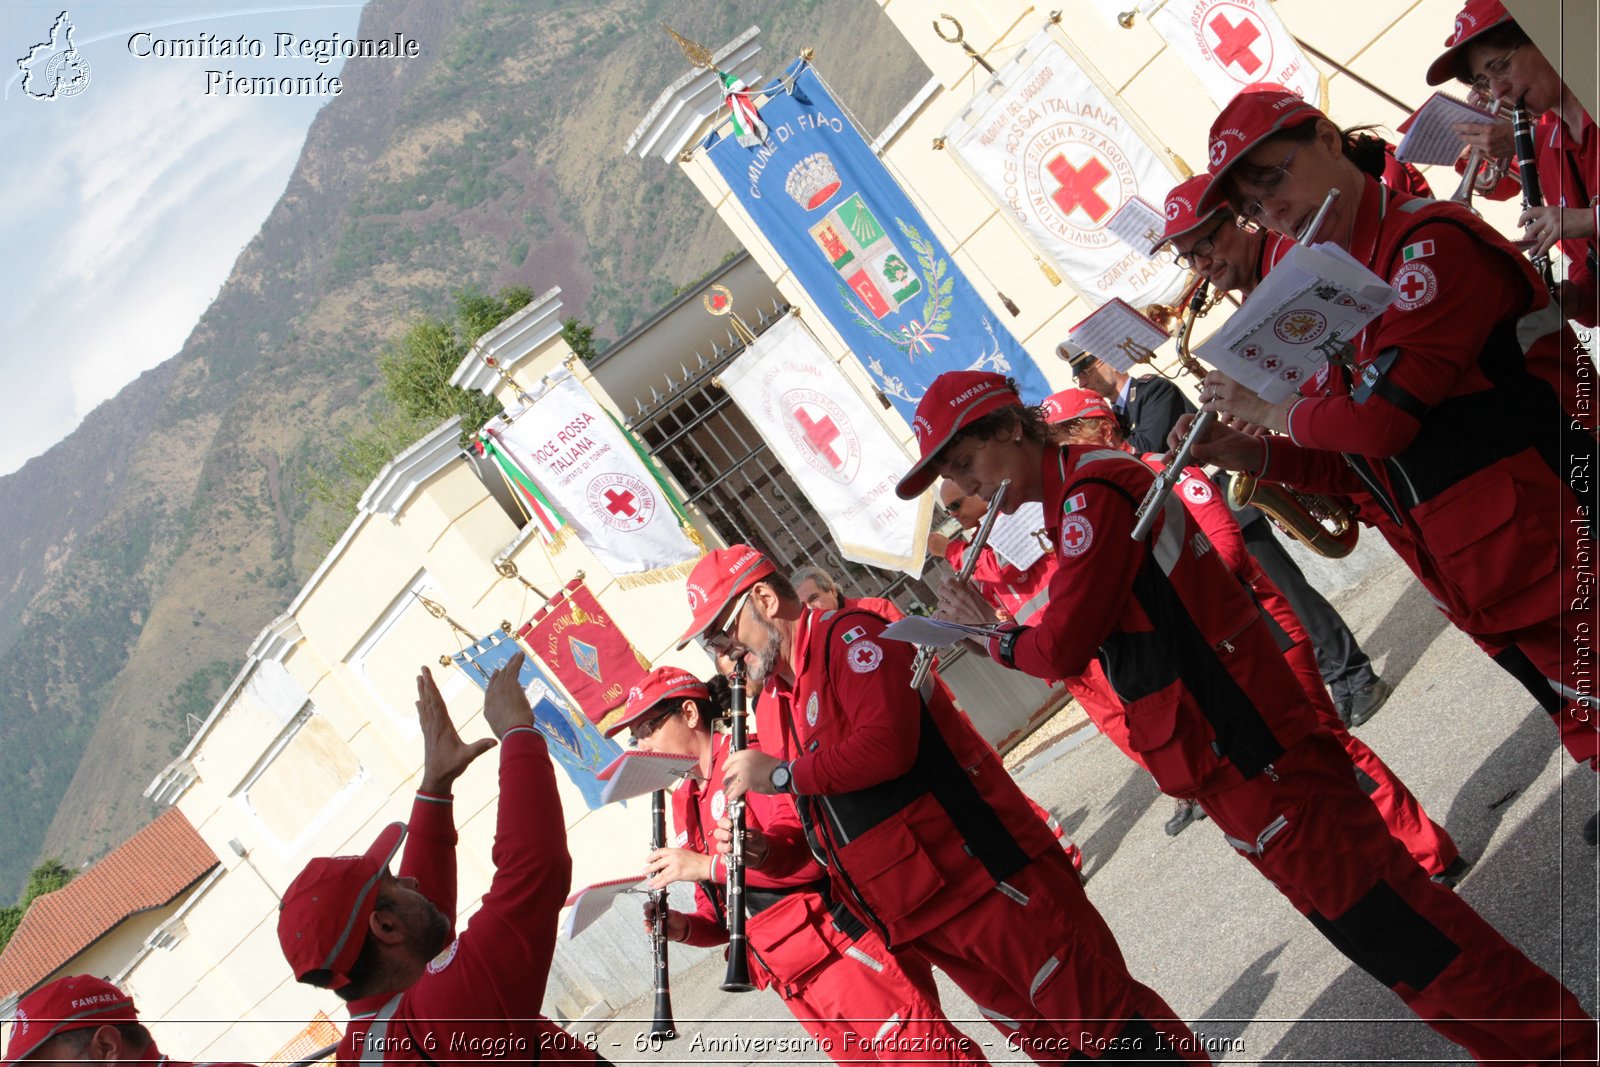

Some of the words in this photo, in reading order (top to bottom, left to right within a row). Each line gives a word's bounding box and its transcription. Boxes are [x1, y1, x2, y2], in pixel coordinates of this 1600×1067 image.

[1040, 98, 1120, 132] ITALIANA
[775, 122, 795, 143] DI
[1005, 107, 1042, 158] ROSSA
[1081, 128, 1097, 143] 22
[1098, 139, 1134, 186] AGOSTO
[1003, 159, 1028, 223] CROCE
[1128, 251, 1173, 292] FIANO
[949, 381, 993, 408] FANFARA
[556, 411, 596, 445] ROSSA
[581, 460, 591, 470] DI
[588, 443, 612, 463] TORINO
[728, 550, 758, 575] FANFARA
[71, 993, 119, 1009] FANFARA
